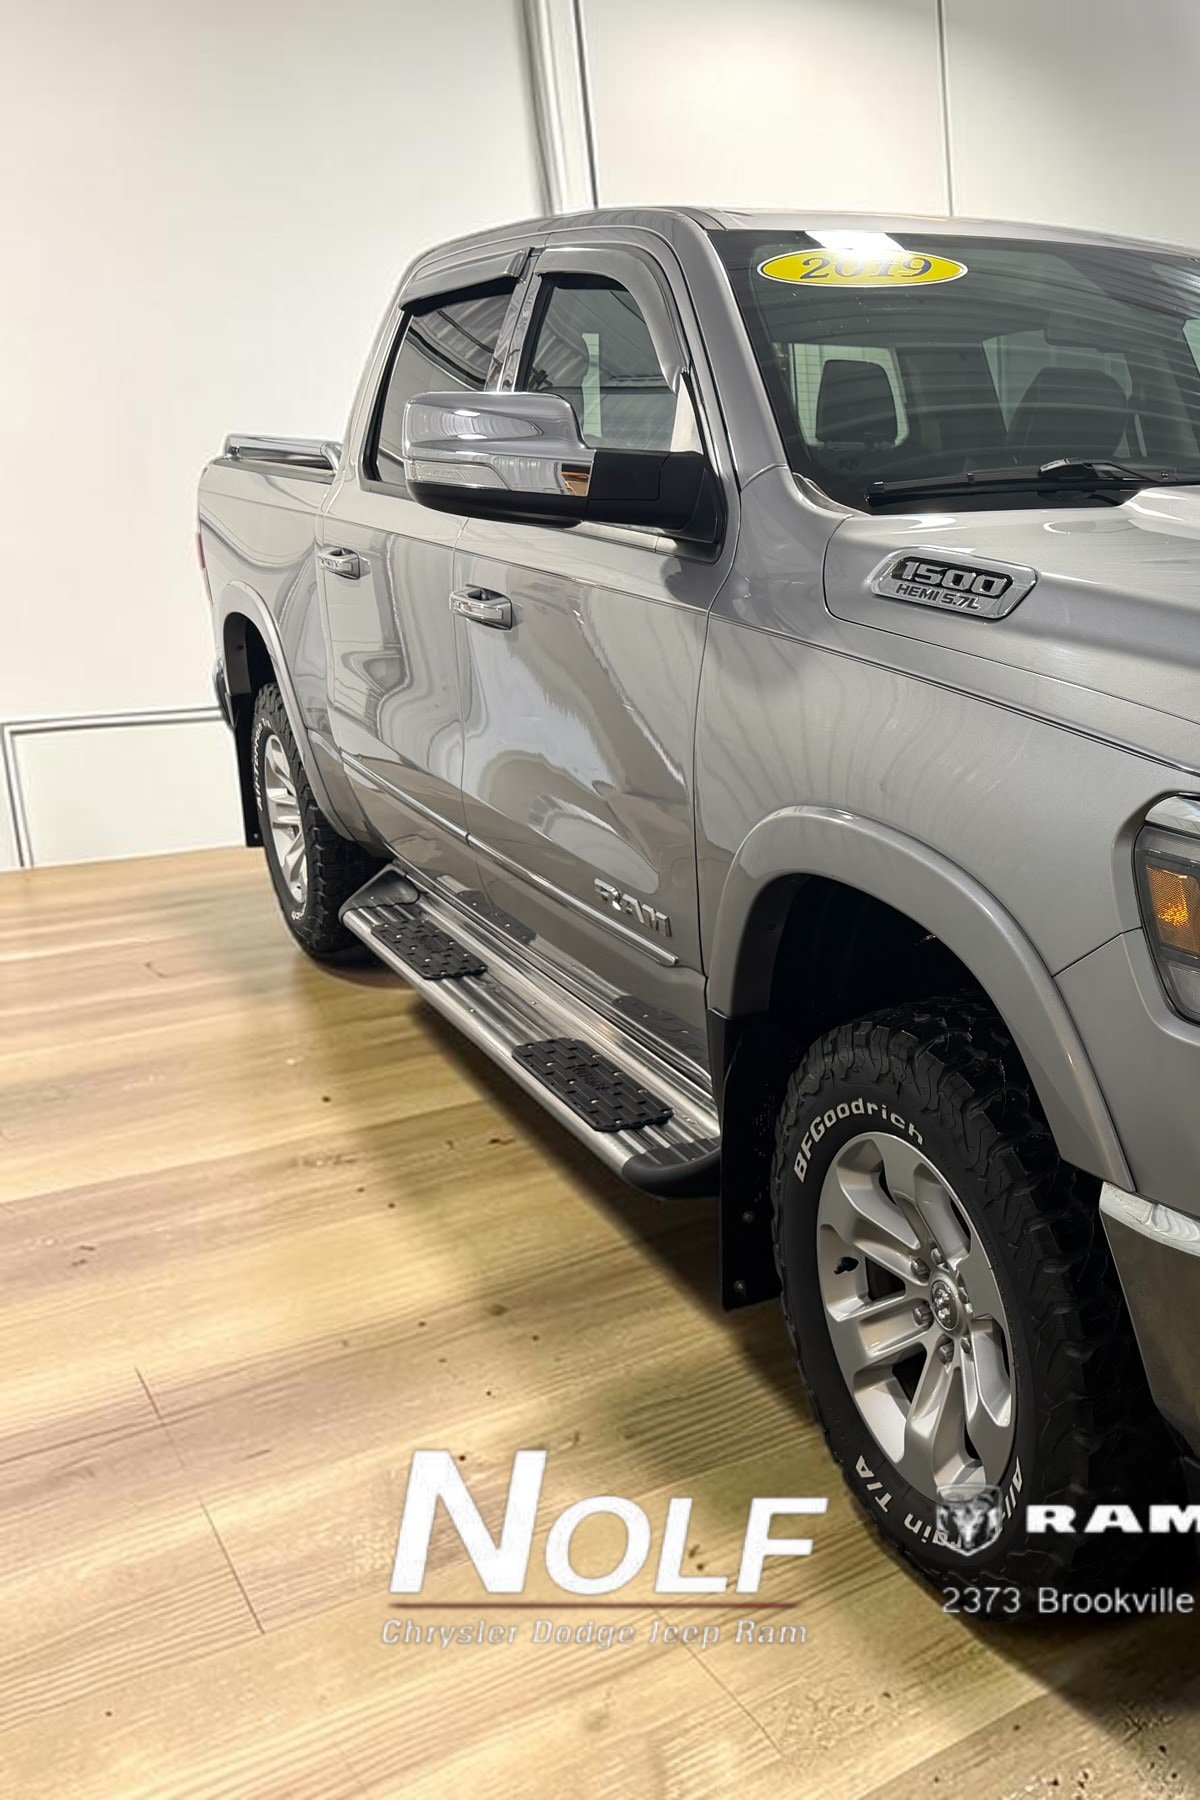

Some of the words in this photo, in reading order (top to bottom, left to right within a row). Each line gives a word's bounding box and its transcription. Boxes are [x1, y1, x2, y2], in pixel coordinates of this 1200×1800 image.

[800, 256, 932, 280] 2019
[896, 583, 941, 602] HEMI
[942, 593, 982, 610] 5.7L
[901, 561, 1008, 597] 1500
[594, 878, 672, 938] RAM
[794, 1097, 924, 1183] BFGoodrich
[855, 1454, 891, 1514] T/A
